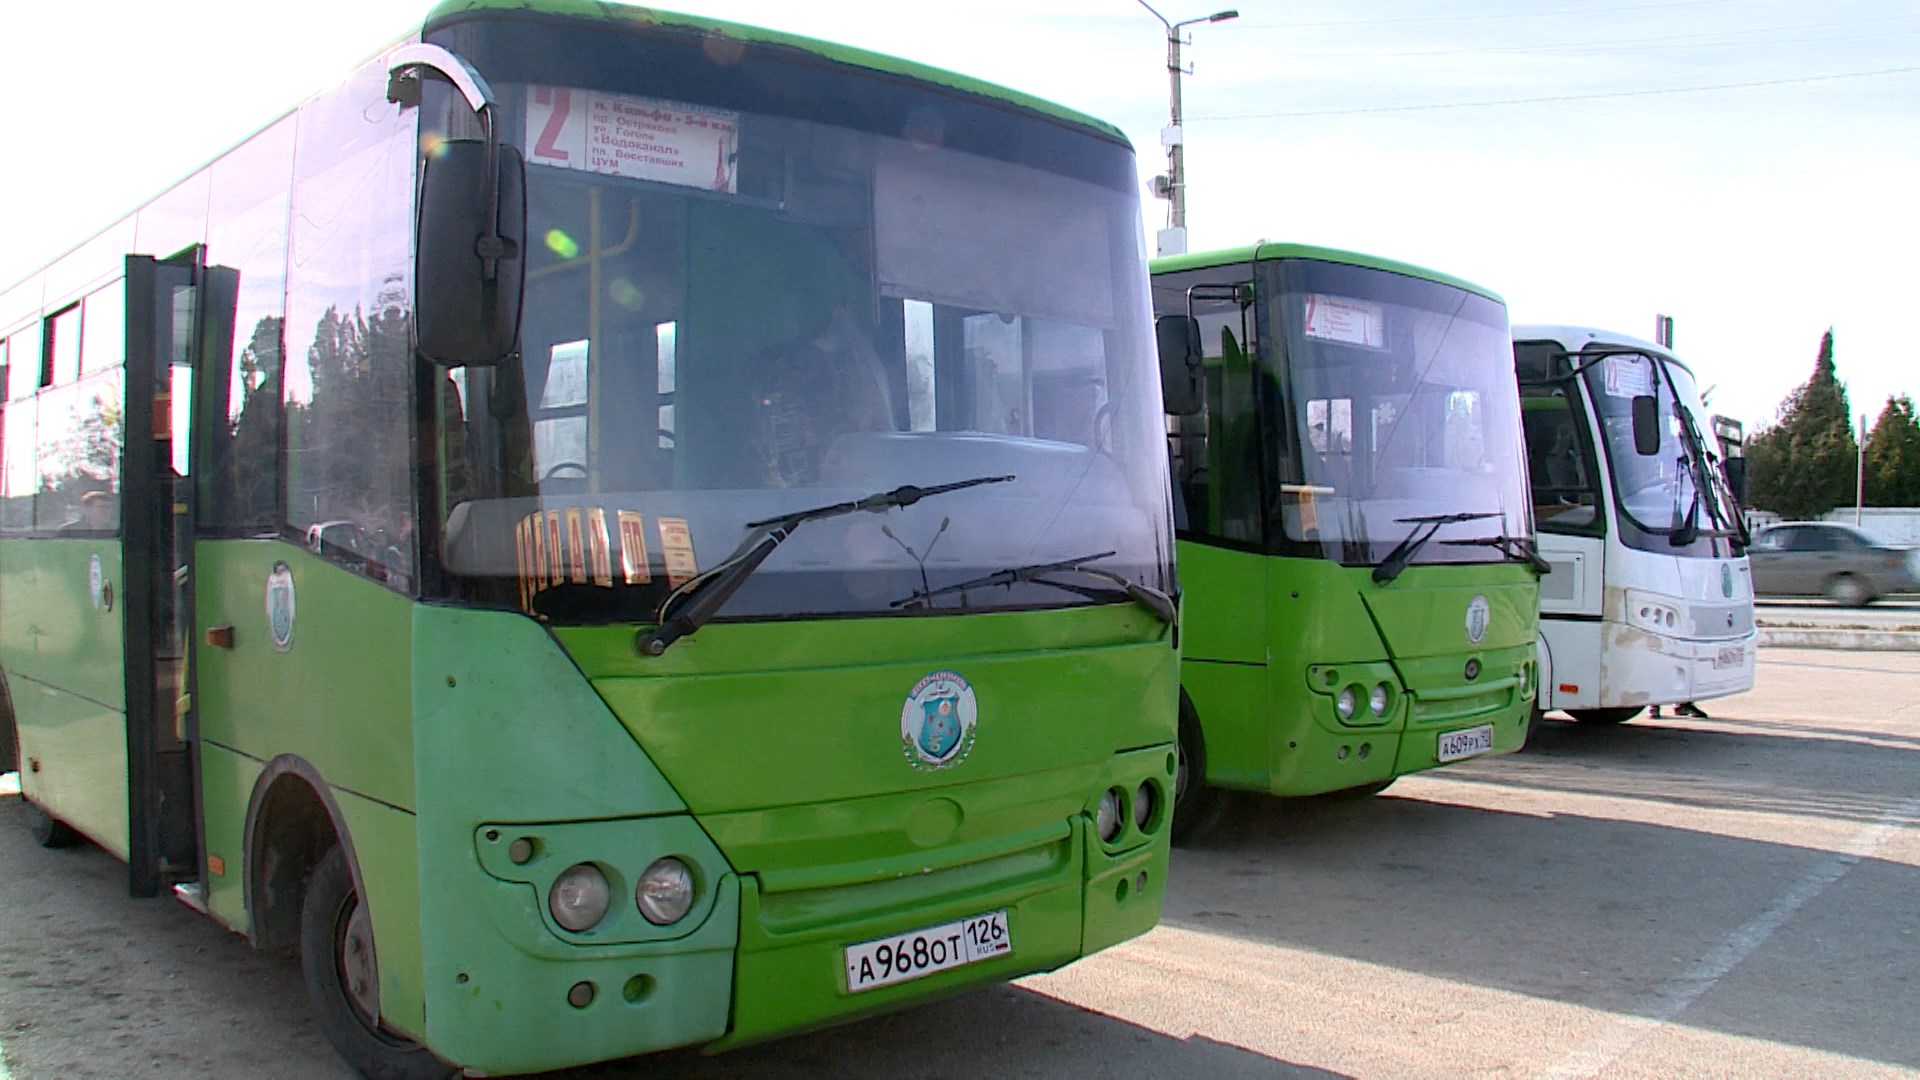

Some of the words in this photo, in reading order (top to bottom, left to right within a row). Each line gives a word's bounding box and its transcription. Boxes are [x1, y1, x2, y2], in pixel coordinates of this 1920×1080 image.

[534, 87, 569, 160] 2
[592, 157, 619, 168] ЦУМ
[859, 935, 960, 983] А968ОТ
[967, 916, 1002, 945] 126
[976, 944, 995, 956] RUS
